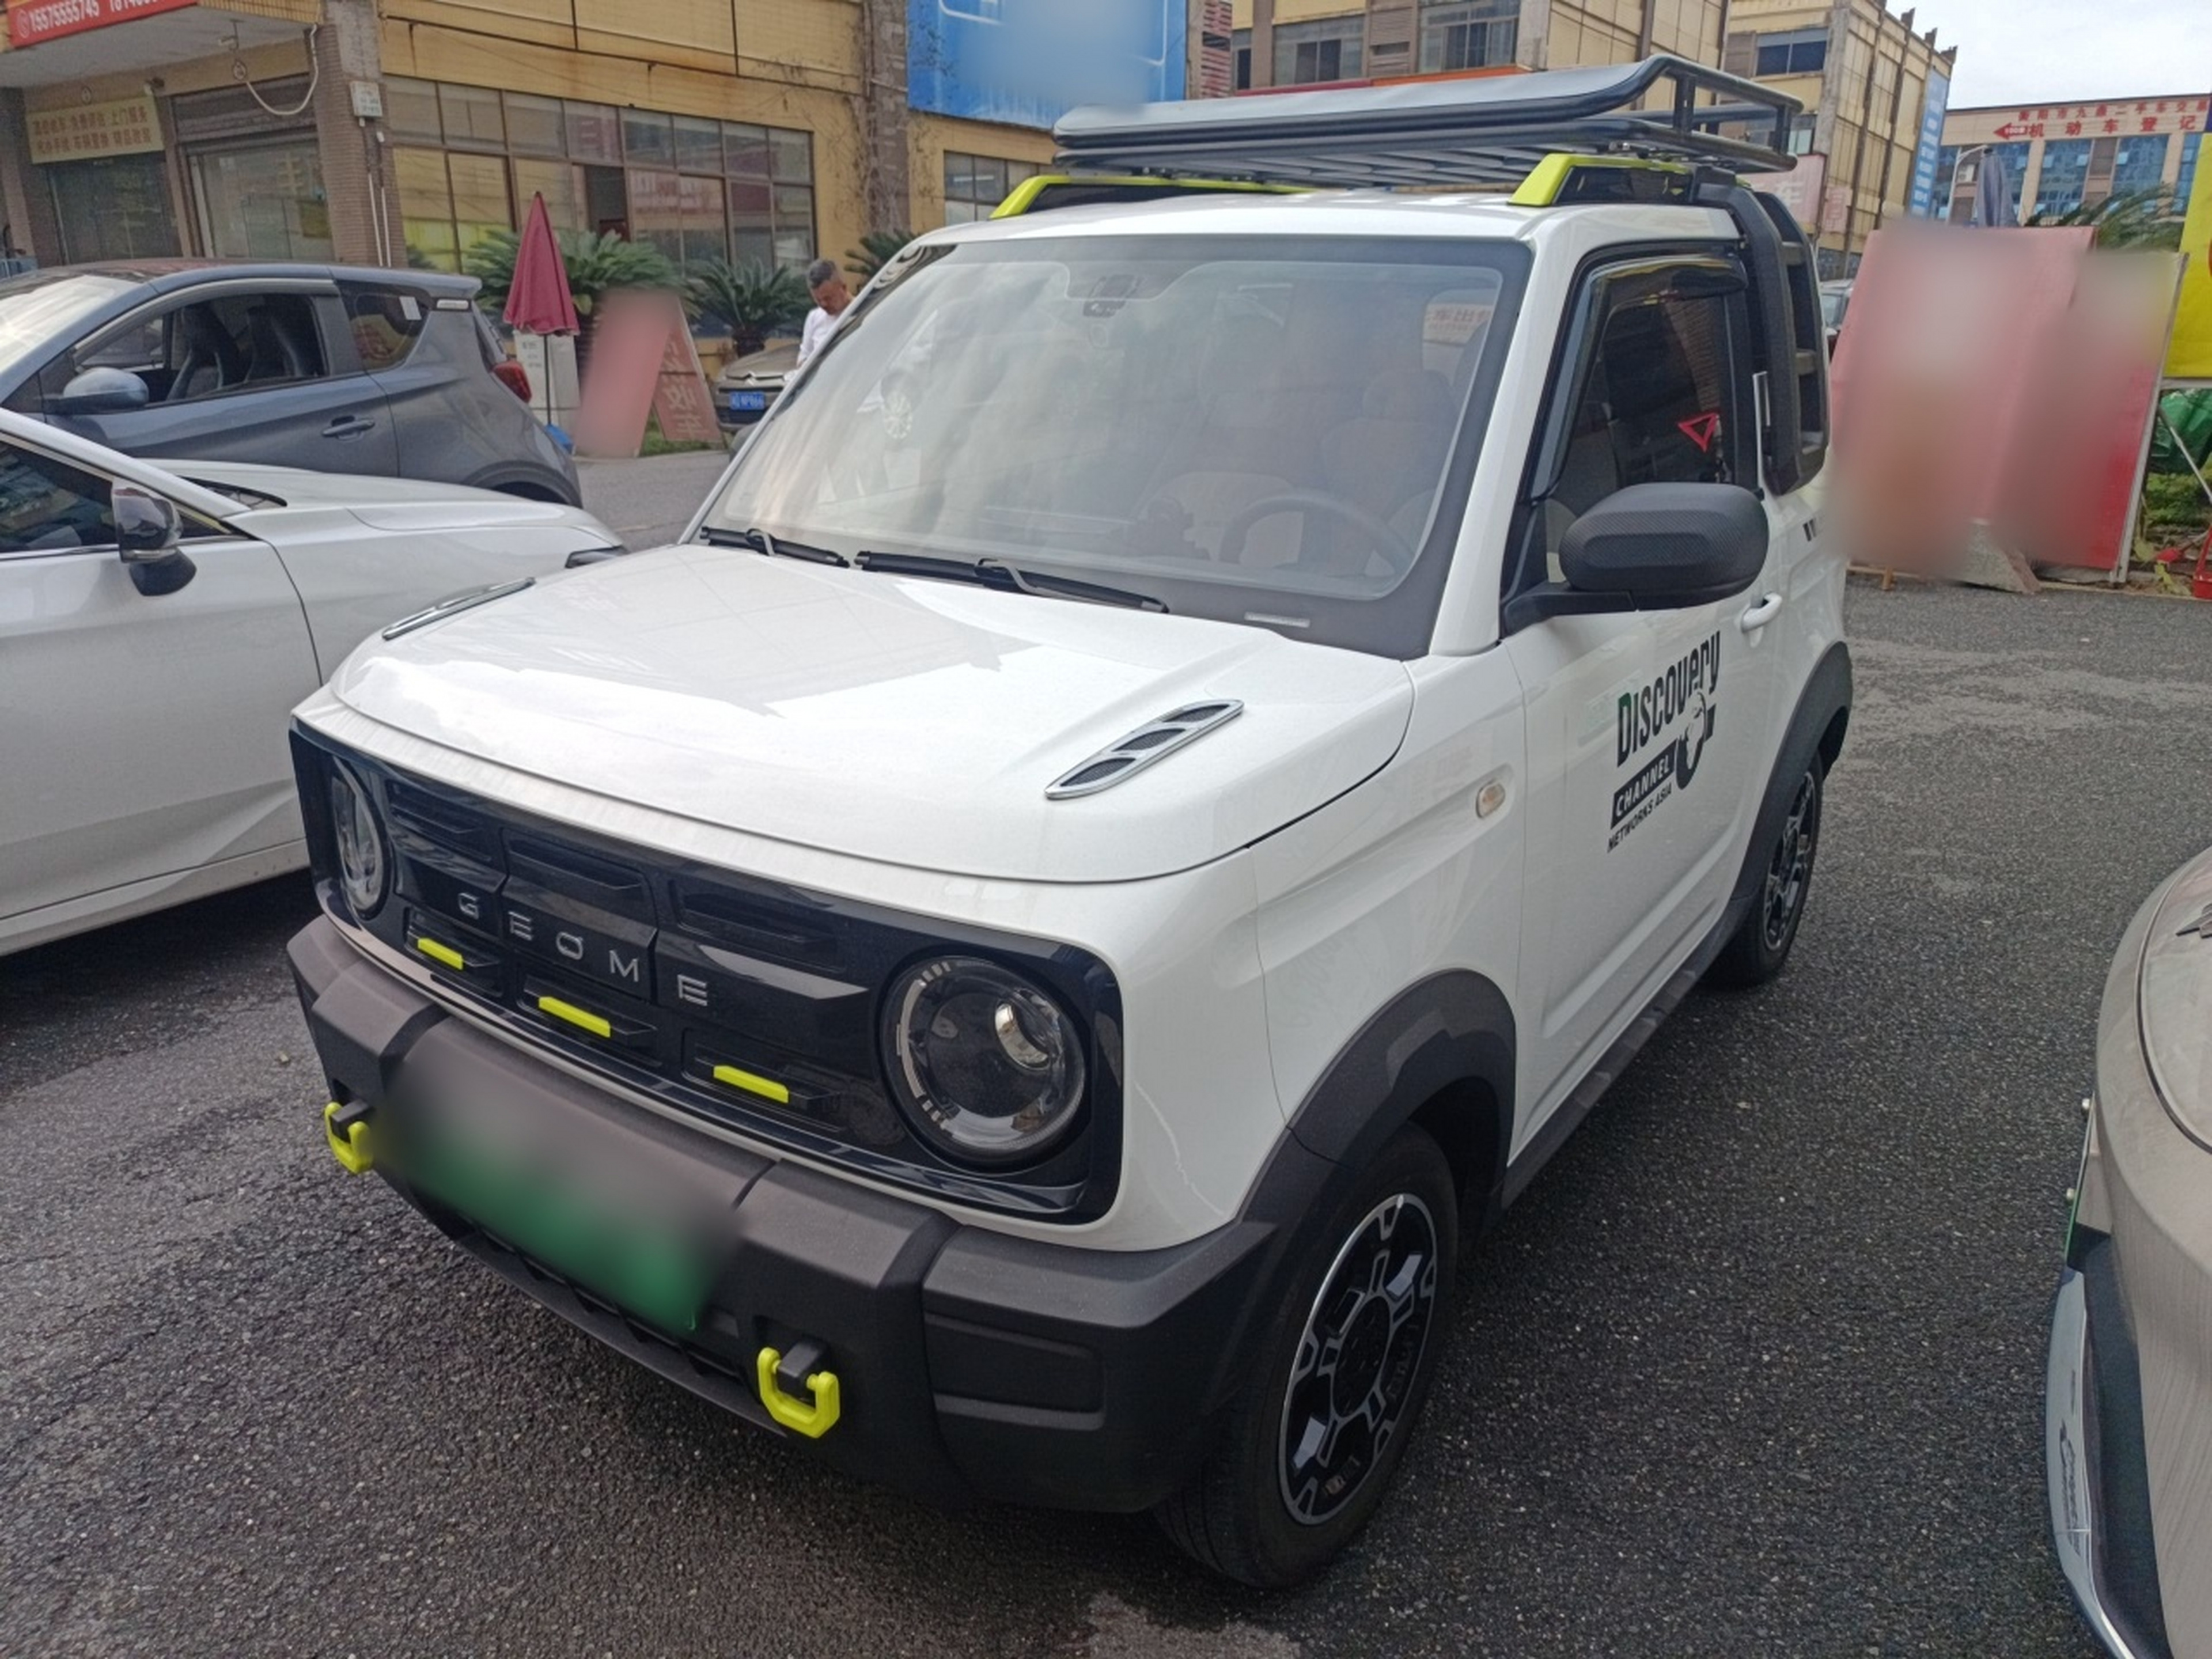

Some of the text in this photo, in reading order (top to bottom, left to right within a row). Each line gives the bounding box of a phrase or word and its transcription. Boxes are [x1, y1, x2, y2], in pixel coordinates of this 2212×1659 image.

[2028, 115, 2196, 138] 机动车登记
[1607, 782, 1672, 853] NETWORKS ASIA
[1615, 753, 1670, 817] CHANNEL
[458, 892, 708, 1006] GEOME
